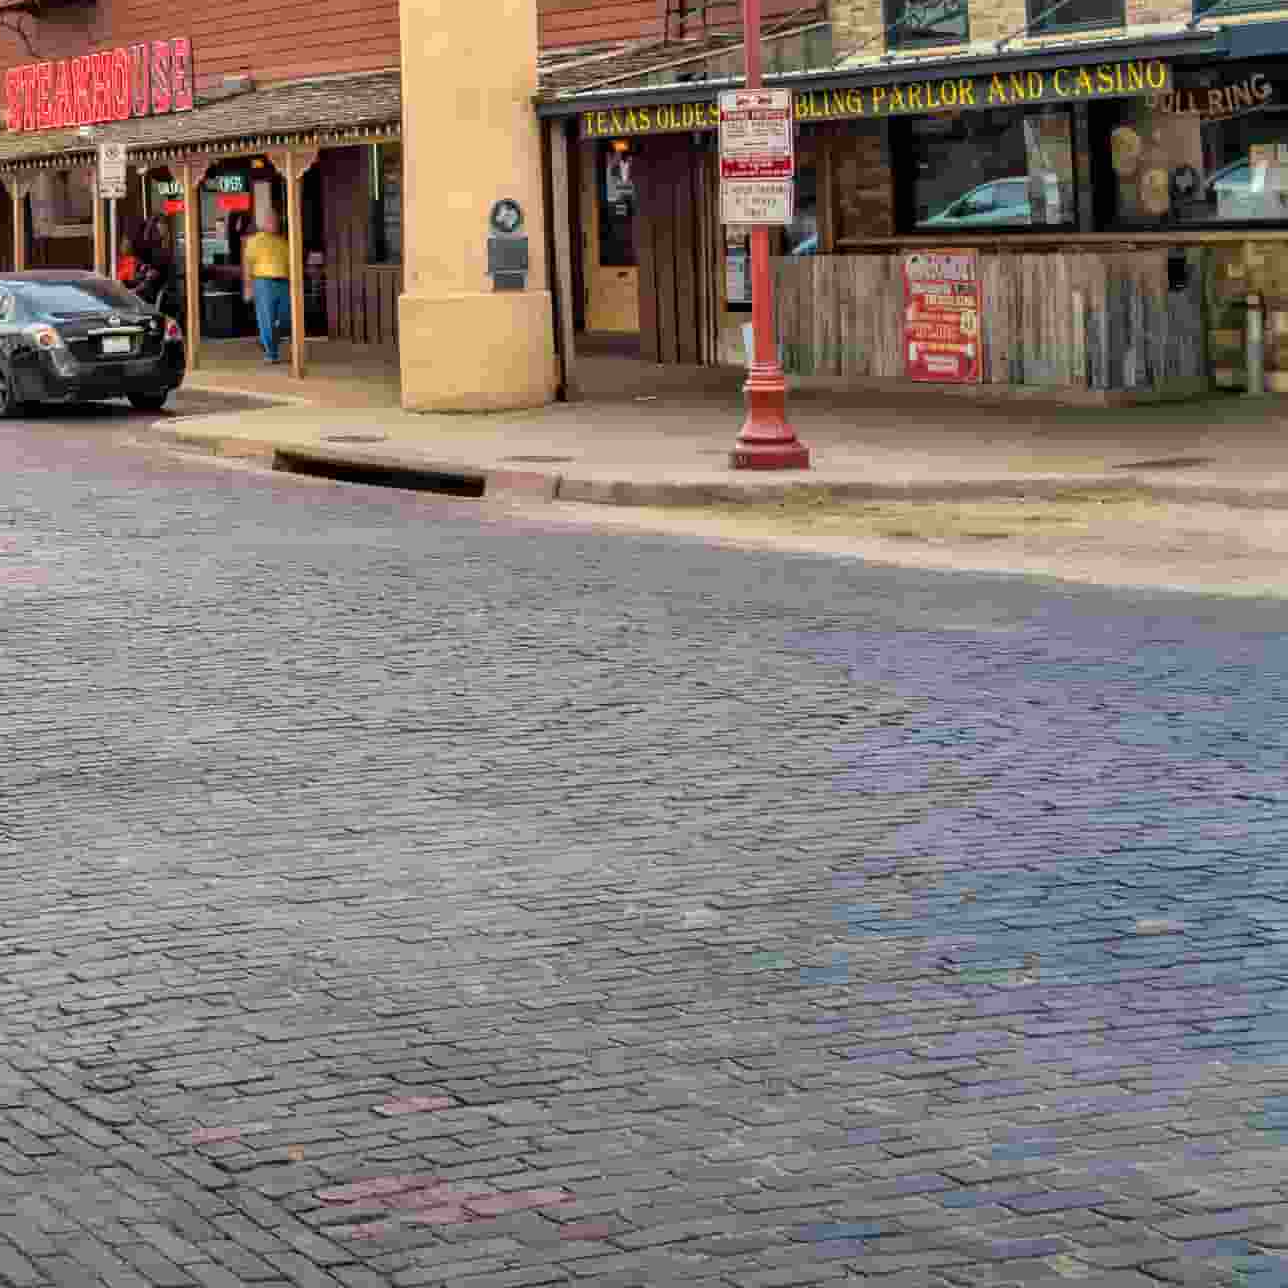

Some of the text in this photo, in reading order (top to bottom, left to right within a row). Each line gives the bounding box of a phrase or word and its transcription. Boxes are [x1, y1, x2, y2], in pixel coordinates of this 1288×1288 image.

[4, 37, 194, 132] STEAKHOUSE
[583, 106, 651, 136] TEXAS
[654, 103, 721, 131] OLDES
[871, 81, 976, 114] PARLOR
[987, 71, 1044, 106] AND
[1055, 58, 1169, 98] CASINO
[1205, 72, 1274, 114] RING
